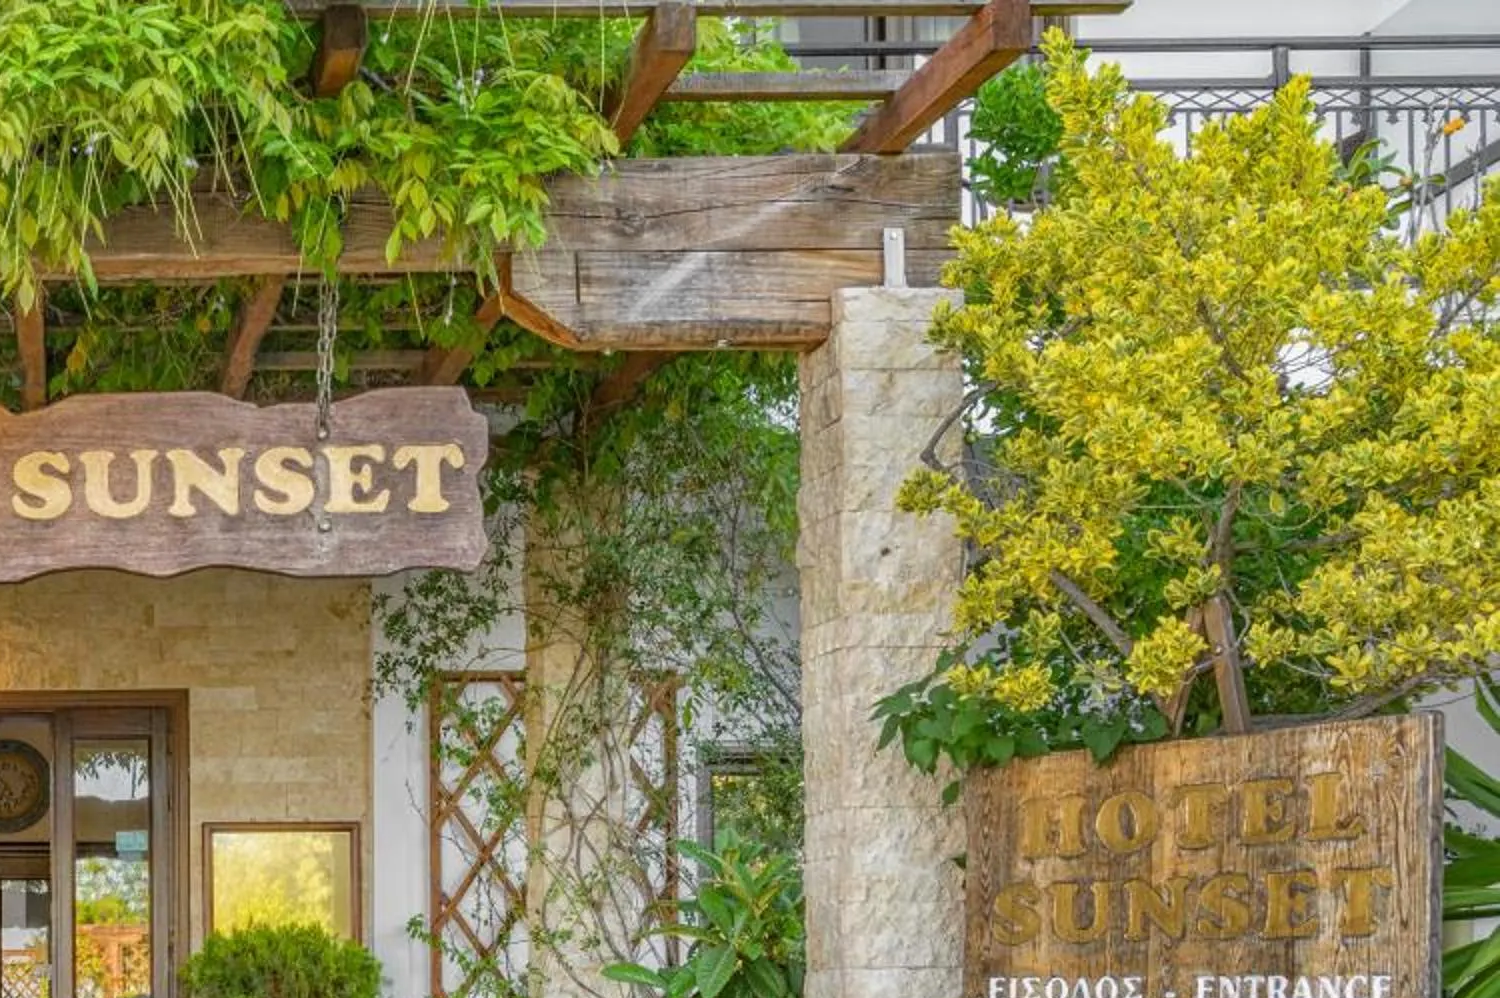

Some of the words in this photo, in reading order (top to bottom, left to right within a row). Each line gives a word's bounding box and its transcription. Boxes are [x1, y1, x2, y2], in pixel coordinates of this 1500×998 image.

[11, 441, 466, 521] SUNSET
[1019, 772, 1365, 861] HOTEL
[993, 864, 1392, 946] SUNSET
